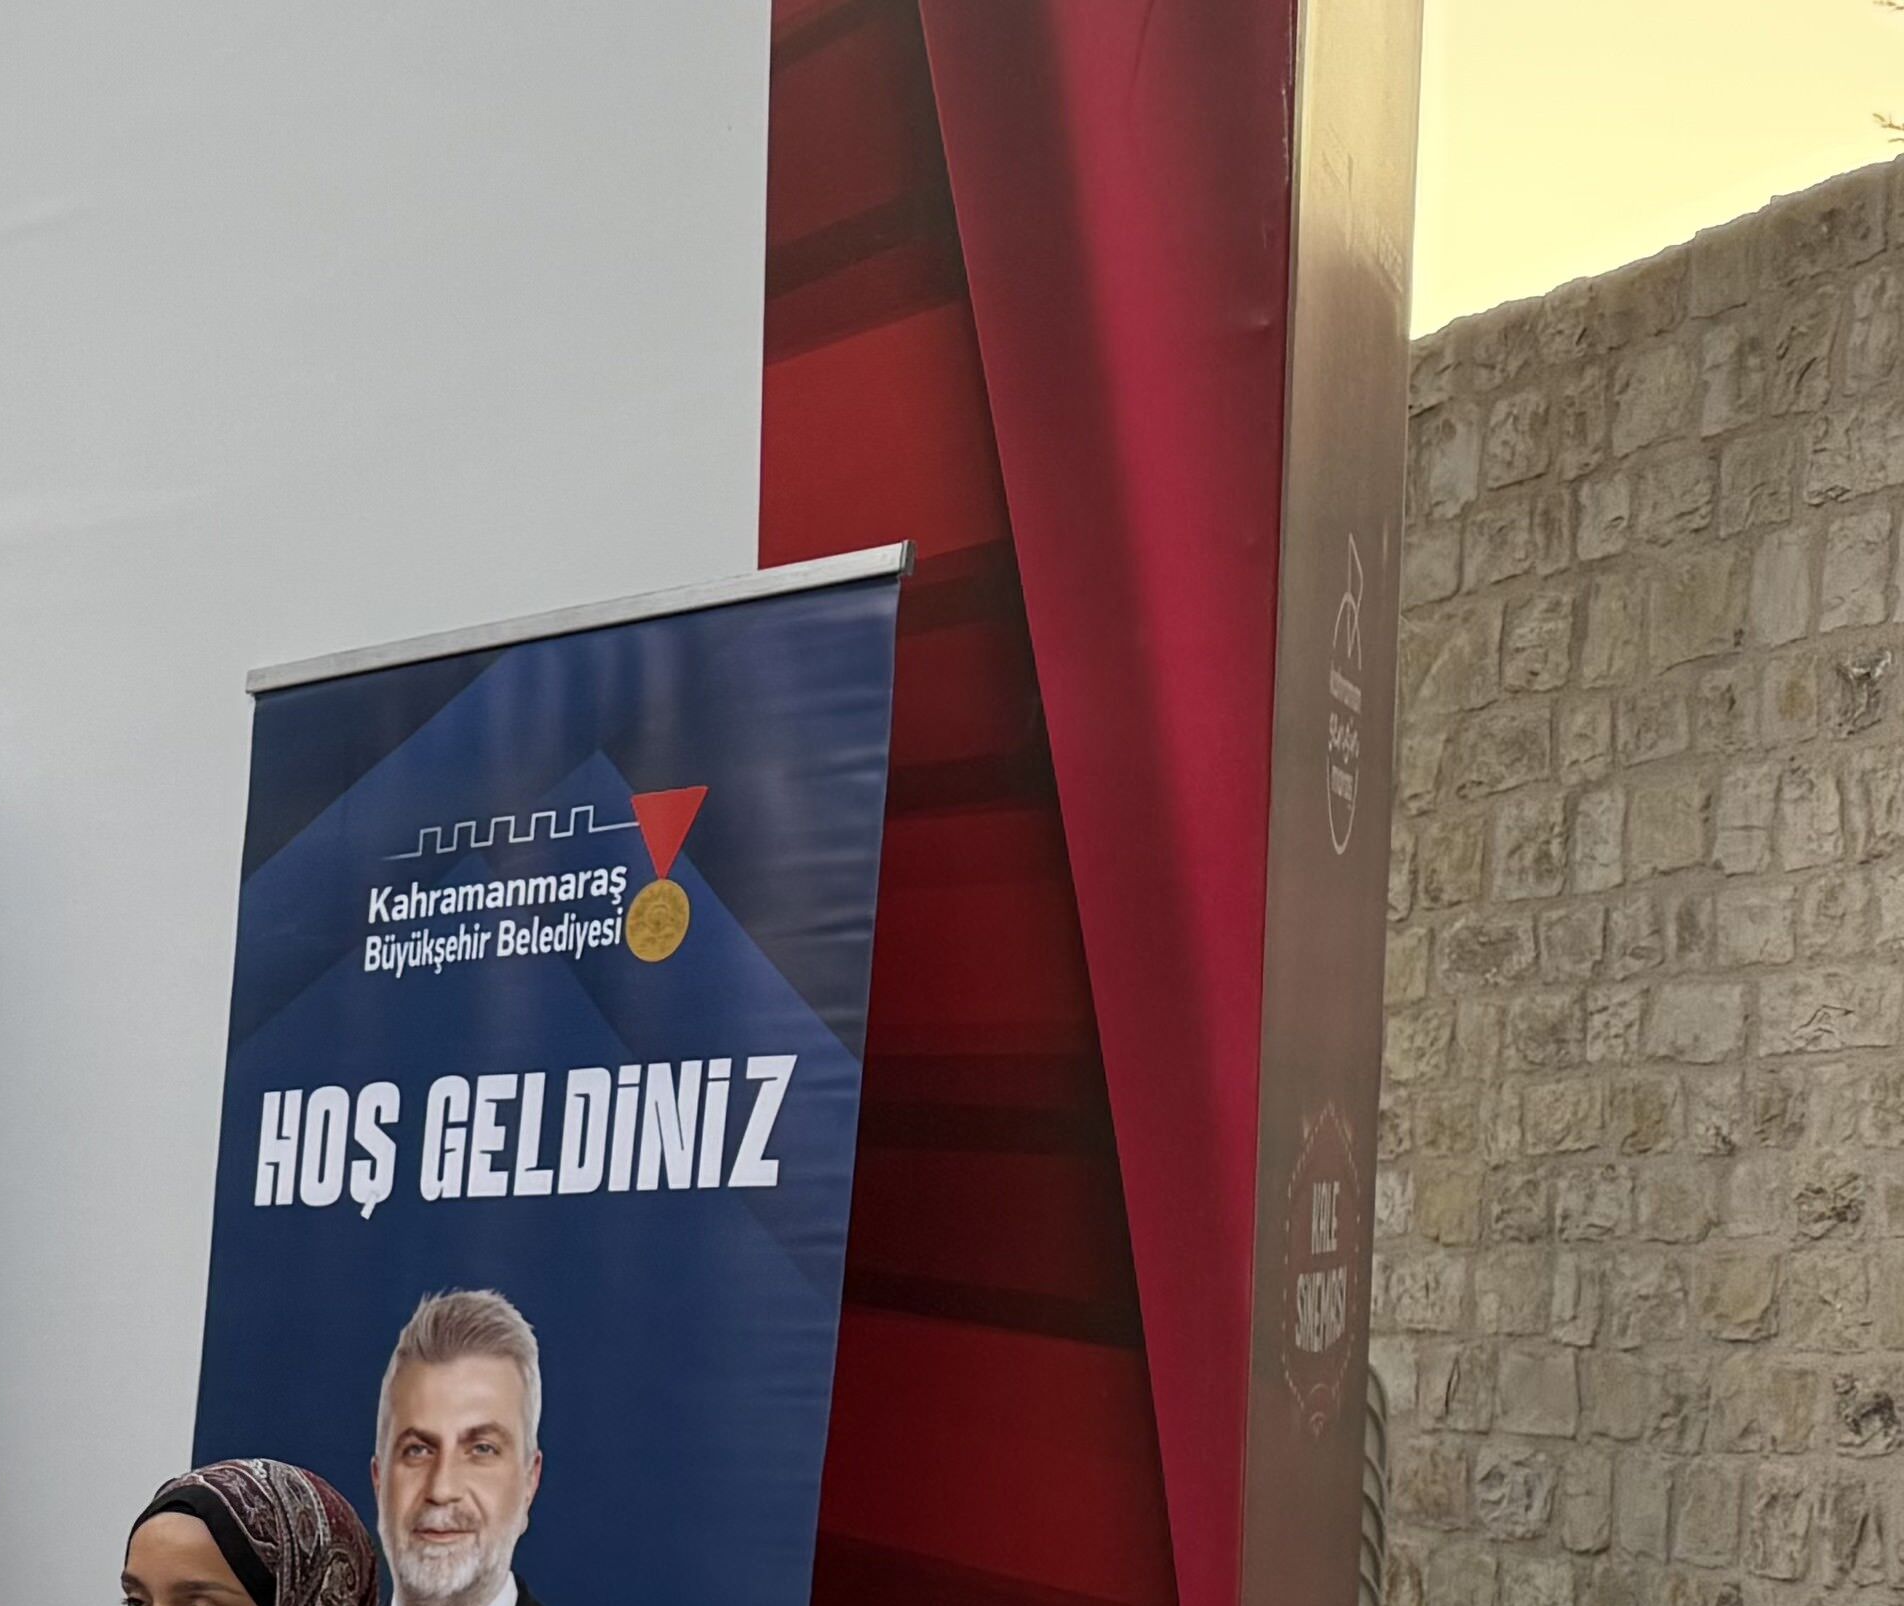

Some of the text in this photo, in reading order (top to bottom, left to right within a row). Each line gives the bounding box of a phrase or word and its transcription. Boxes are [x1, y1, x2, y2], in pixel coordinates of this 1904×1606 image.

[368, 862, 628, 924] Kahramanmaraş
[364, 908, 623, 978] Büyükşehir Belediyesi
[254, 1053, 798, 1220] HOŞ GELDİNİZ
